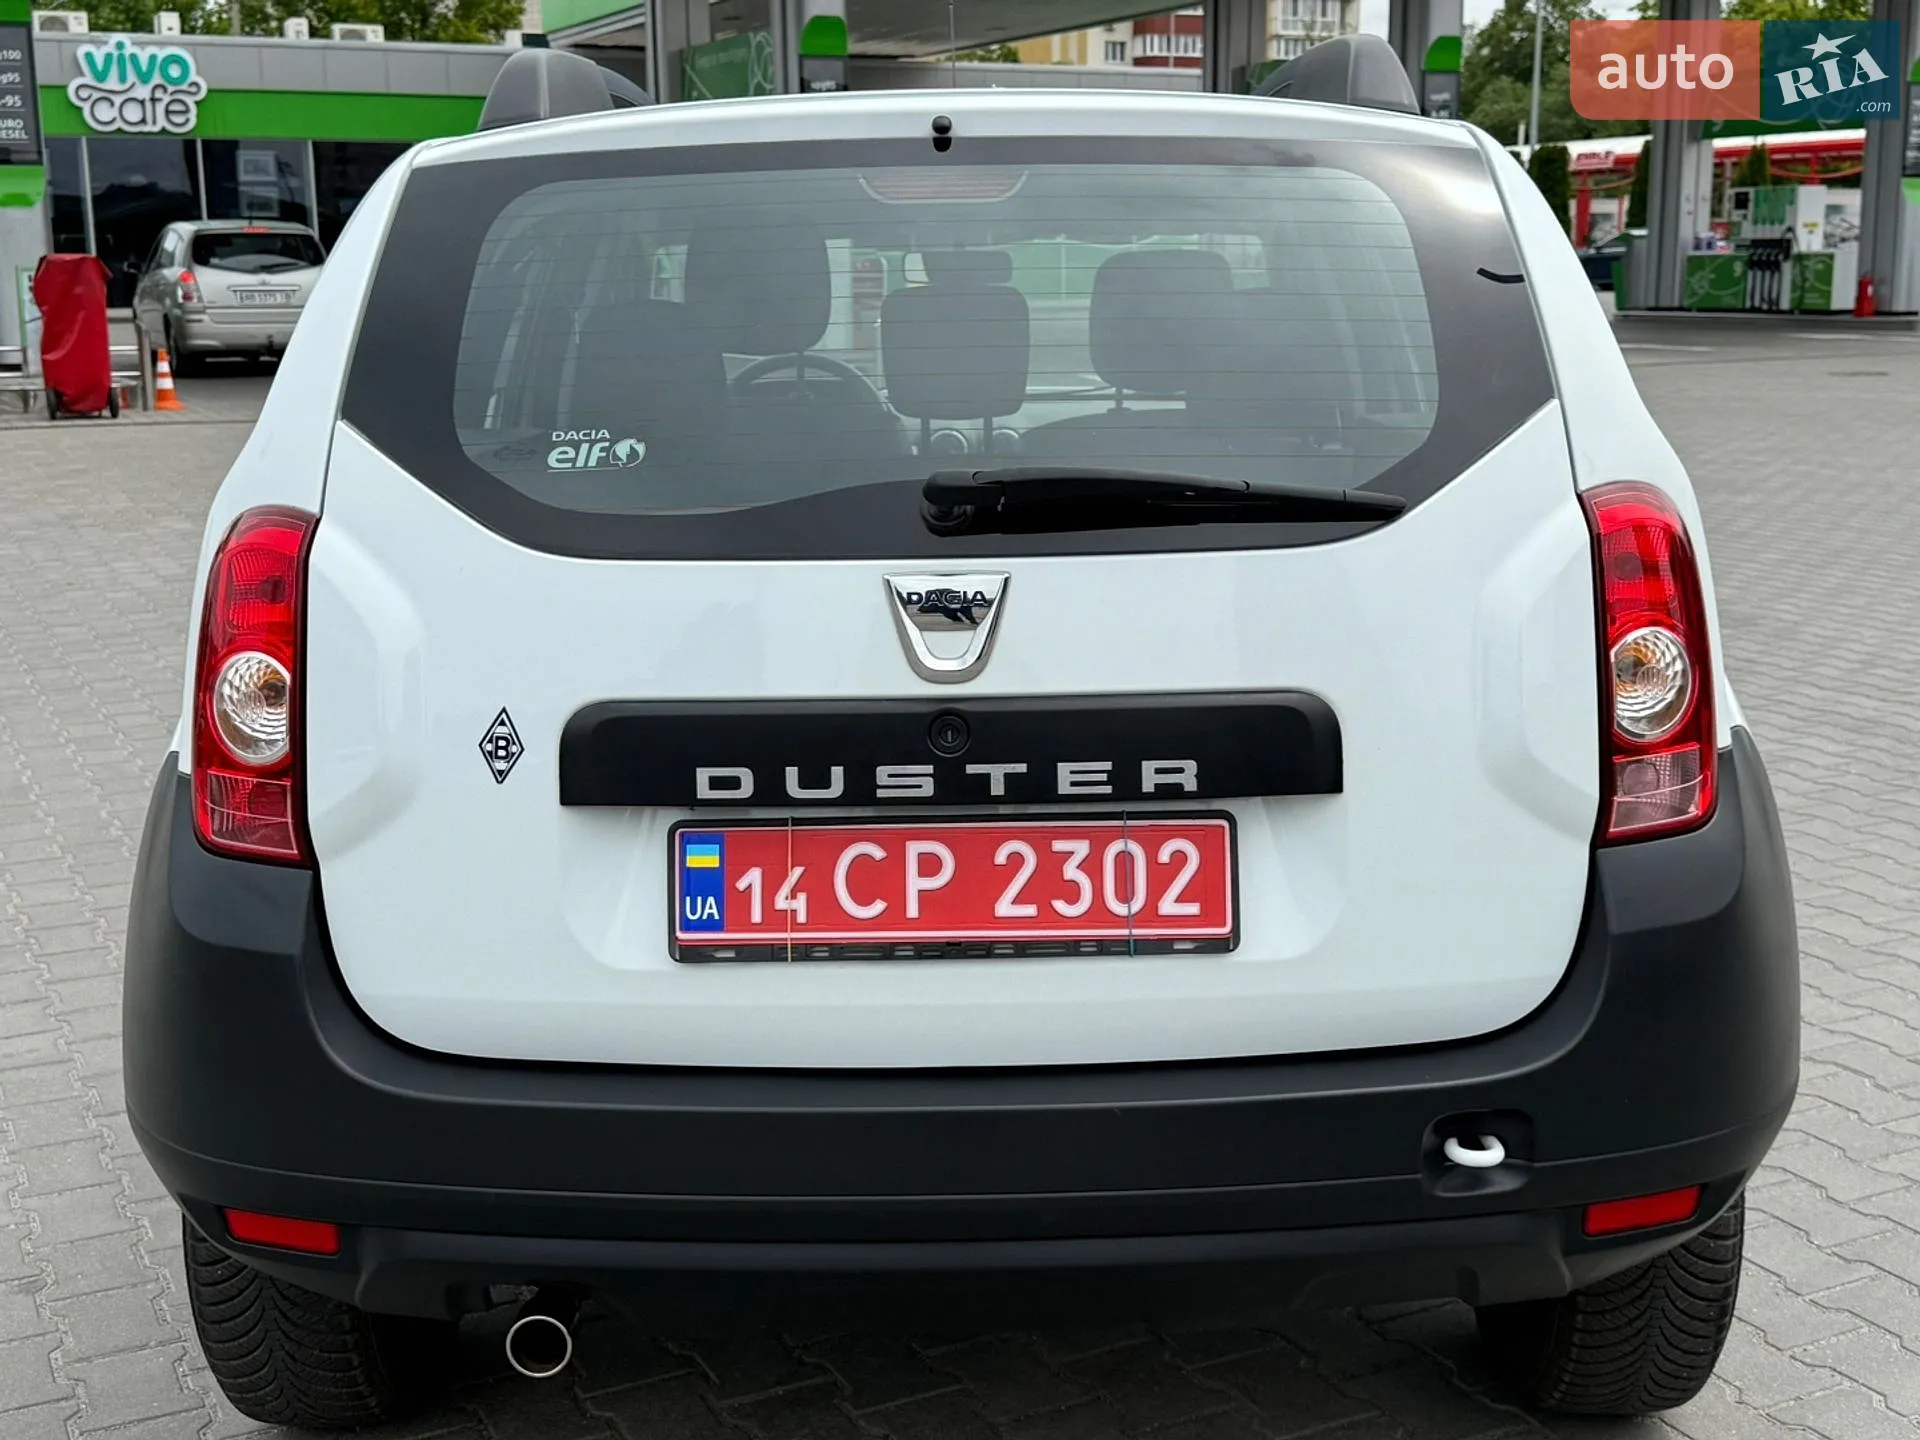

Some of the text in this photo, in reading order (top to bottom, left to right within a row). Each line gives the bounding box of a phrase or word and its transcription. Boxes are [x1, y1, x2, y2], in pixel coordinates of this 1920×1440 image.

[0, 49, 22, 60] 100
[84, 40, 190, 86] vivo
[551, 429, 611, 441] DACIA
[547, 442, 610, 468] elf
[906, 590, 988, 606] DACIA
[494, 736, 511, 760] B
[696, 760, 1198, 799] DUSTER
[735, 838, 1201, 924] 14 CP 2302
[685, 896, 720, 920] UA
